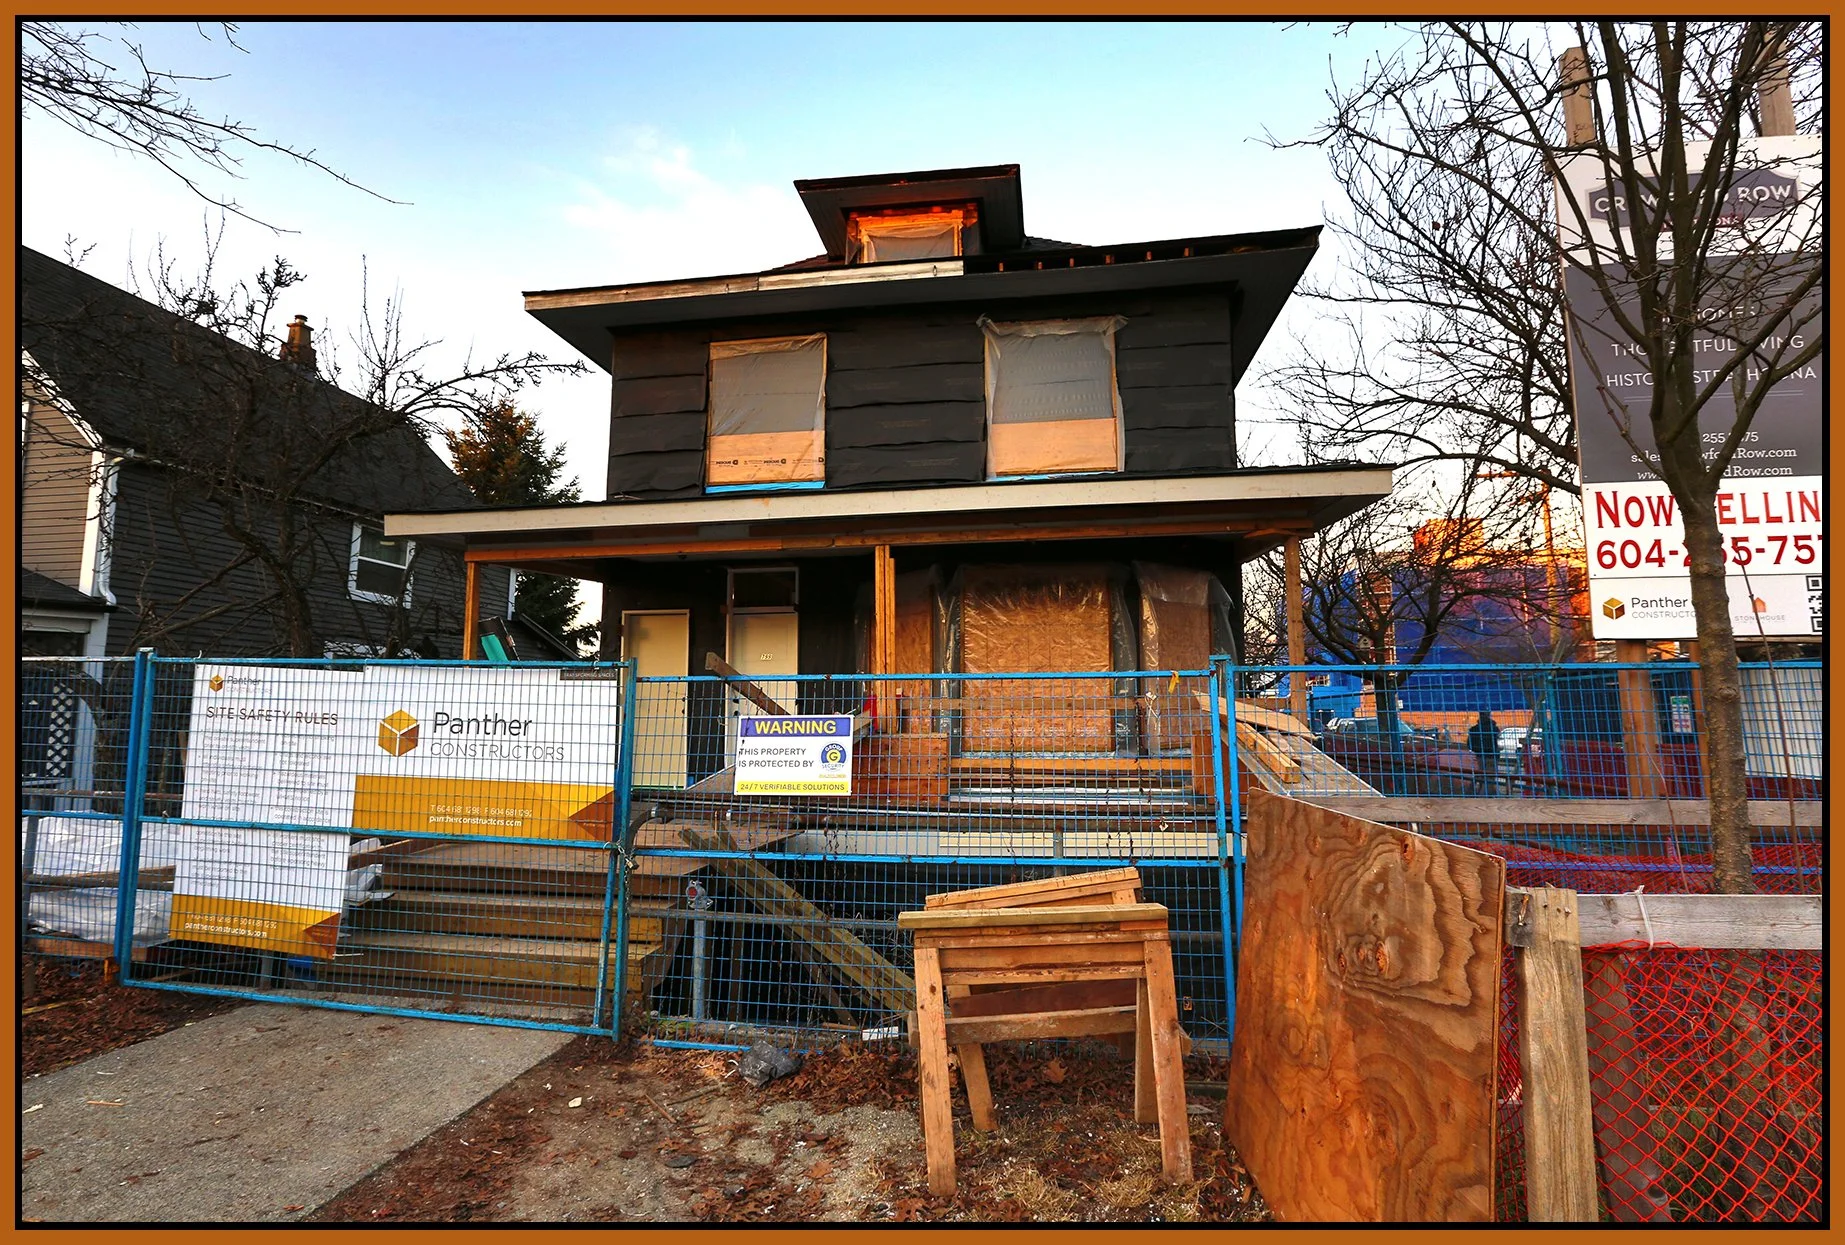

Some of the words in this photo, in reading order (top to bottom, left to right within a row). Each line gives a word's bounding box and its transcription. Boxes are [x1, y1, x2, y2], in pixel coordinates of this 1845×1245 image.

[1737, 184, 1791, 203] ROW
[1611, 338, 1737, 357] THOTFUL
[1759, 335, 1805, 350] VING
[1702, 432, 1726, 444] 255
[1595, 490, 1676, 528] NOW
[1714, 490, 1822, 525] ELLIN
[1631, 596, 1689, 609] Panther
[1631, 610, 1697, 619] CONSTRUCTO
[1734, 614, 1786, 622] STONHOUSE
[227, 676, 261, 686] Panther
[206, 706, 235, 720] SITE
[239, 708, 291, 723] SAFETY
[295, 711, 339, 726] RULES
[432, 711, 533, 737] Panther
[754, 720, 837, 735] WARNING
[430, 742, 565, 761] CONSTRUCTORS
[740, 748, 759, 756] THIS
[760, 748, 807, 756] PROPERTY
[738, 760, 747, 768] IS
[748, 760, 801, 768] PROTECTED
[802, 760, 815, 768] BY
[802, 783, 845, 791] SOLUTIONS
